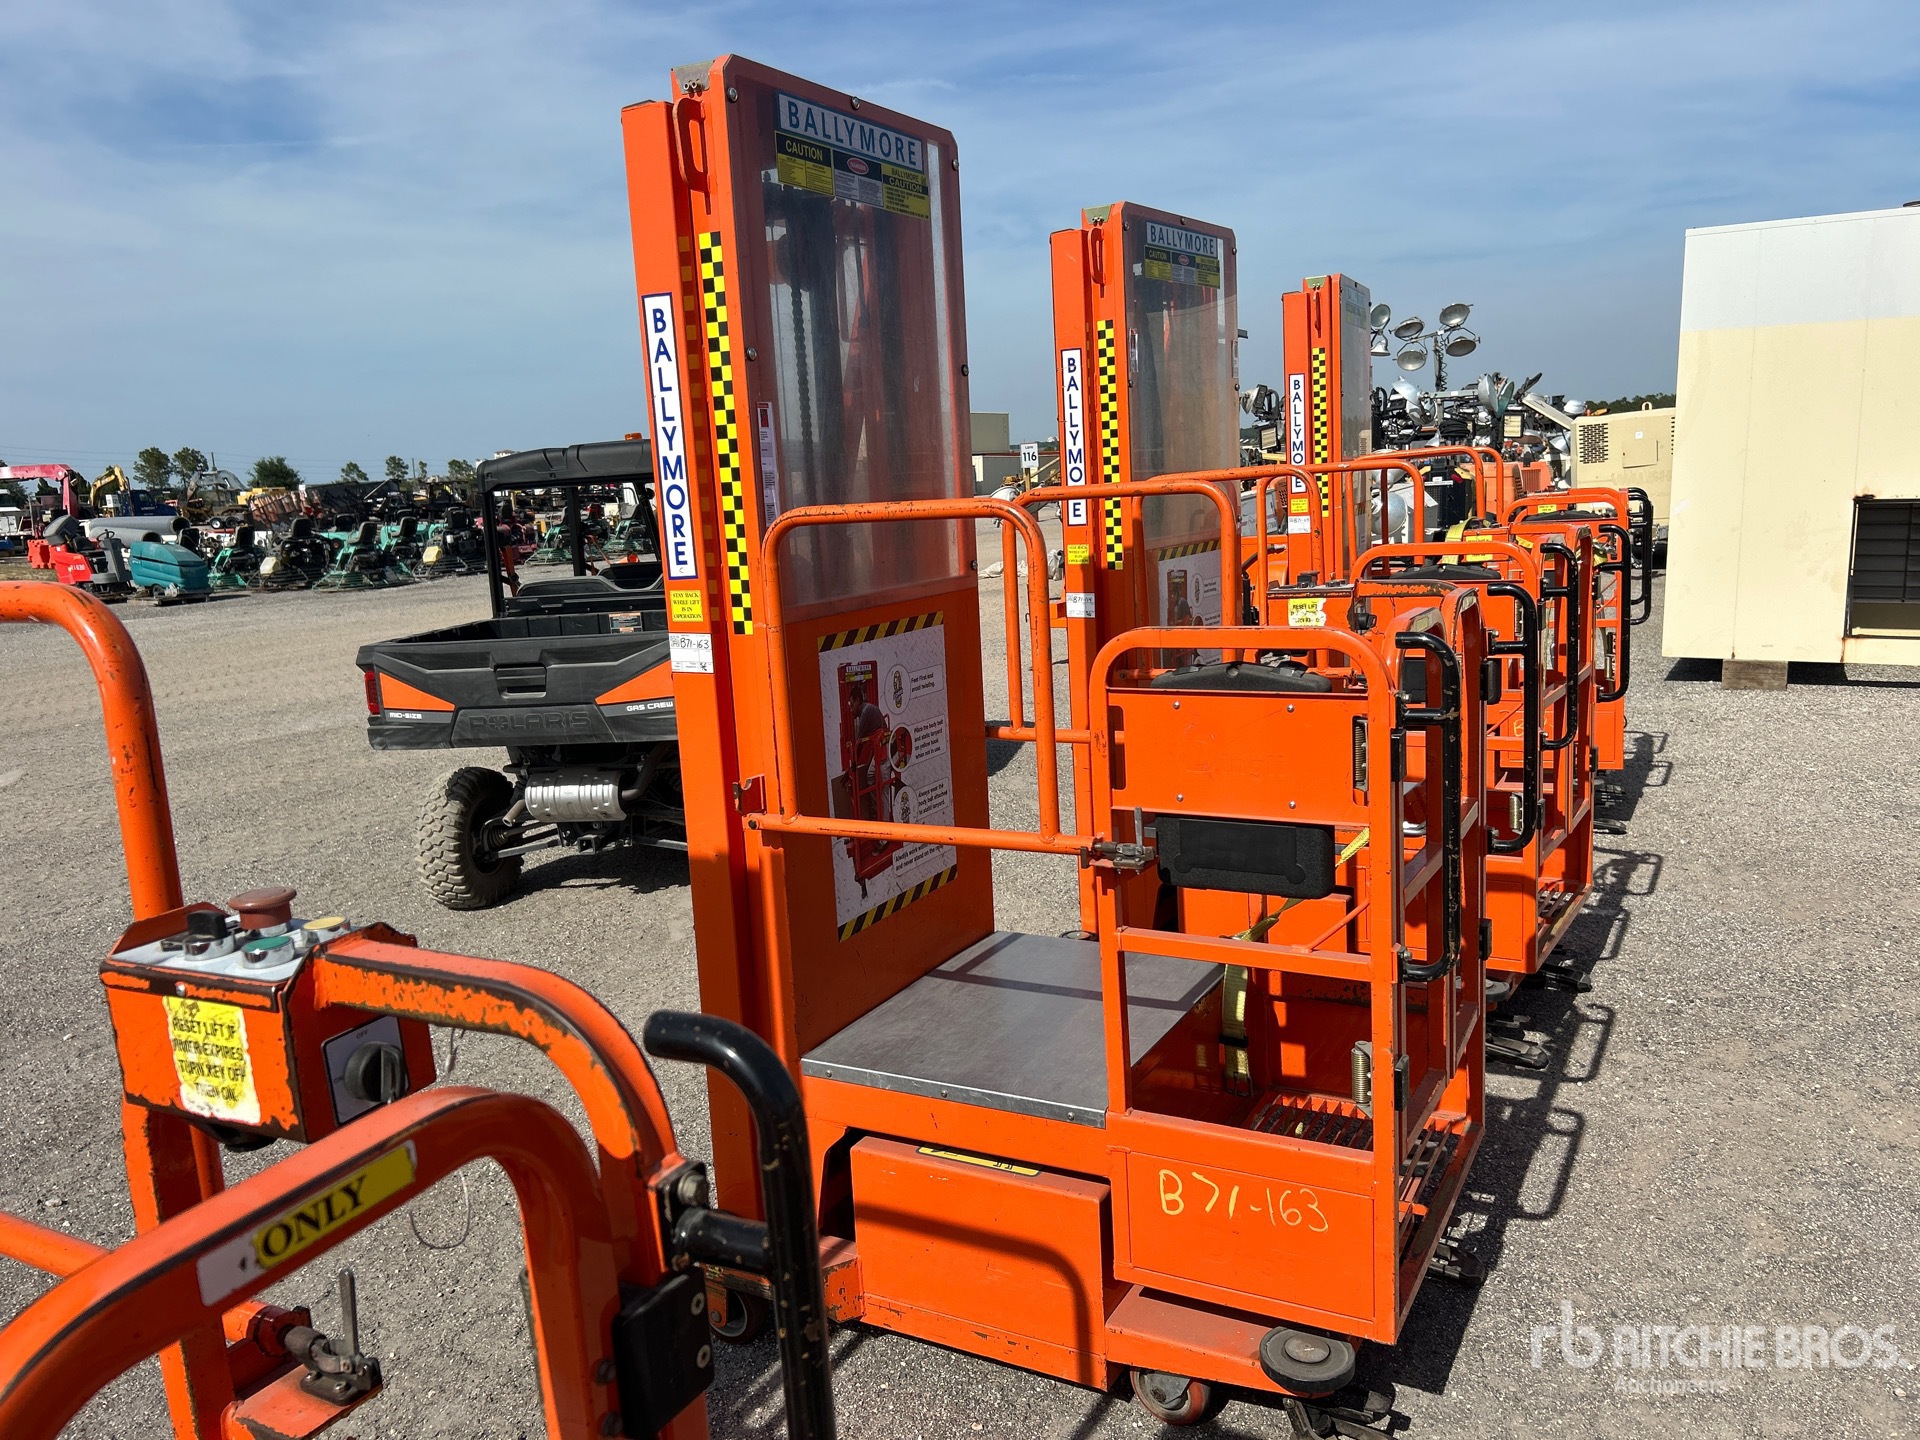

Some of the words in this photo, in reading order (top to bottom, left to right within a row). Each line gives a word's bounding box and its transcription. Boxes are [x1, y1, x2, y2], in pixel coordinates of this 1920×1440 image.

[787, 100, 917, 166] BALLYMORE
[785, 139, 823, 161] CAUTION
[889, 177, 923, 193] CAUTION
[891, 168, 919, 183] BALLYMORE
[1150, 225, 1214, 255] BALLYMORE
[1148, 249, 1168, 260] CAUTION
[652, 308, 689, 566] BALLYMORE
[1066, 357, 1083, 518] BALLYMOE
[1292, 379, 1304, 488] BALLYMOE
[1022, 451, 1037, 462] 116
[680, 637, 710, 650] B71-163
[389, 711, 422, 720] MID-SIZE
[626, 704, 646, 712] GAS
[647, 700, 673, 709] CREW
[467, 710, 591, 732] POLARIS
[172, 1017, 201, 1034] RESET
[203, 1021, 224, 1037] LIFT
[203, 1042, 244, 1061] EXPIRES
[177, 1059, 205, 1077] TURN
[205, 1063, 225, 1079] KEY
[262, 1174, 367, 1257] ONLY
